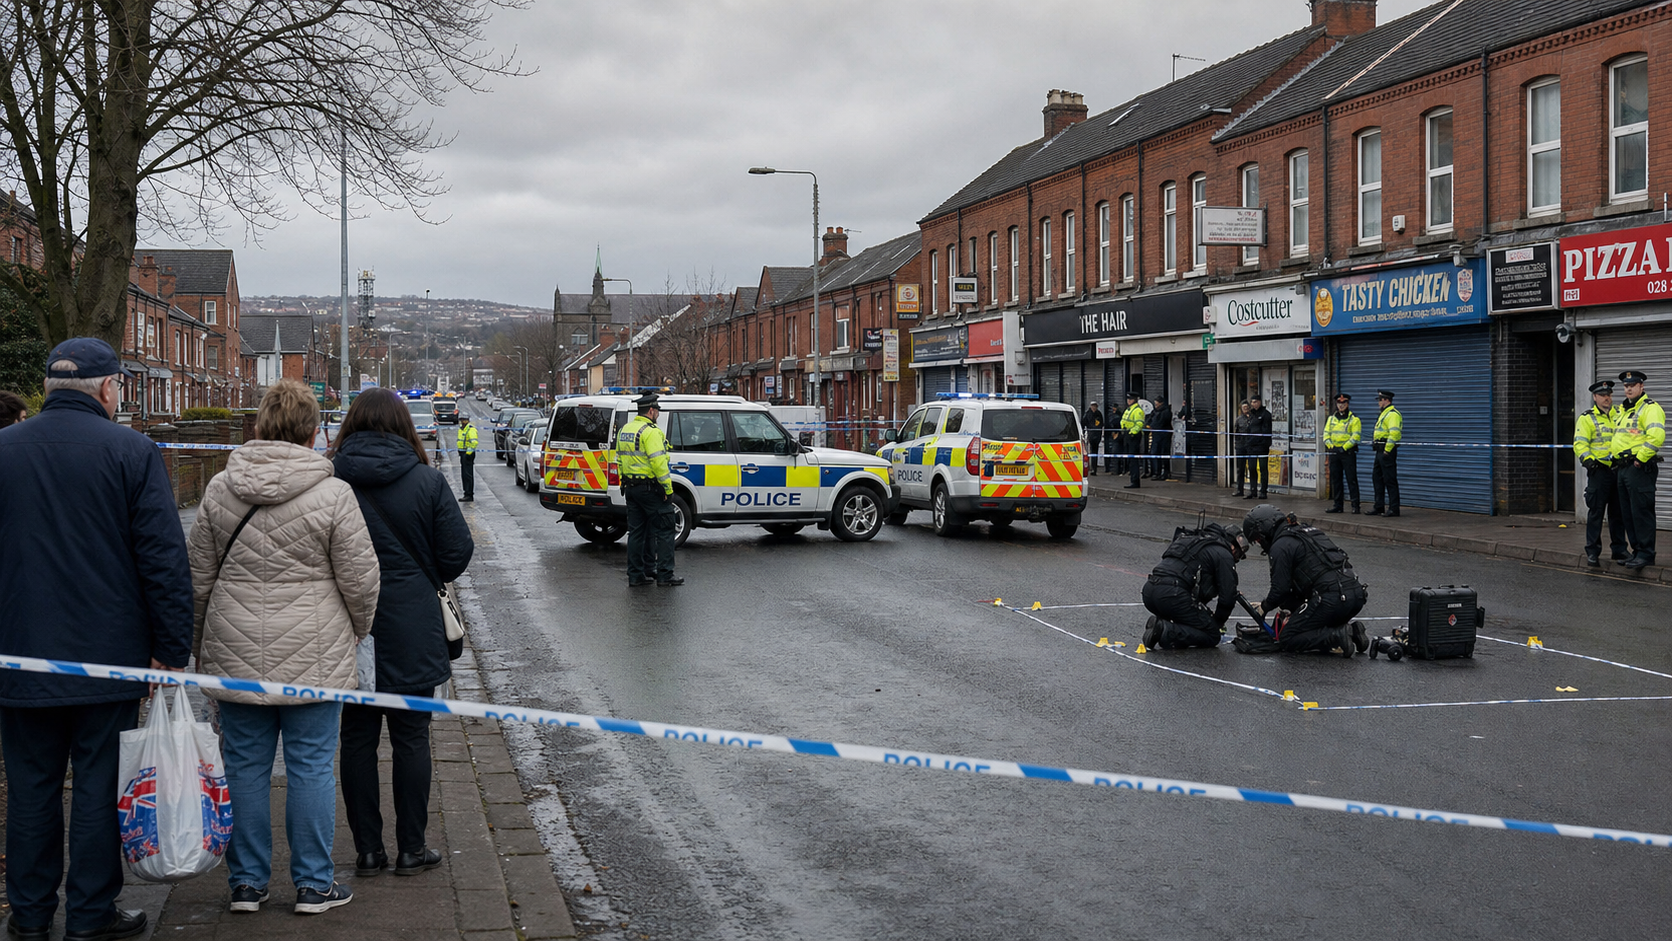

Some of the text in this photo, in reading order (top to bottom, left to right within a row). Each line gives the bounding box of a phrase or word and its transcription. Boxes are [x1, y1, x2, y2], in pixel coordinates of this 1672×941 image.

[1563, 239, 1662, 283] PIZZA
[1342, 280, 1385, 312] TASTY
[1388, 270, 1451, 308] CHICKEN
[1647, 279, 1667, 294] 028
[1079, 310, 1127, 334] THE HAIR
[1227, 296, 1293, 326] Costcutter
[721, 492, 802, 506] POLICE
